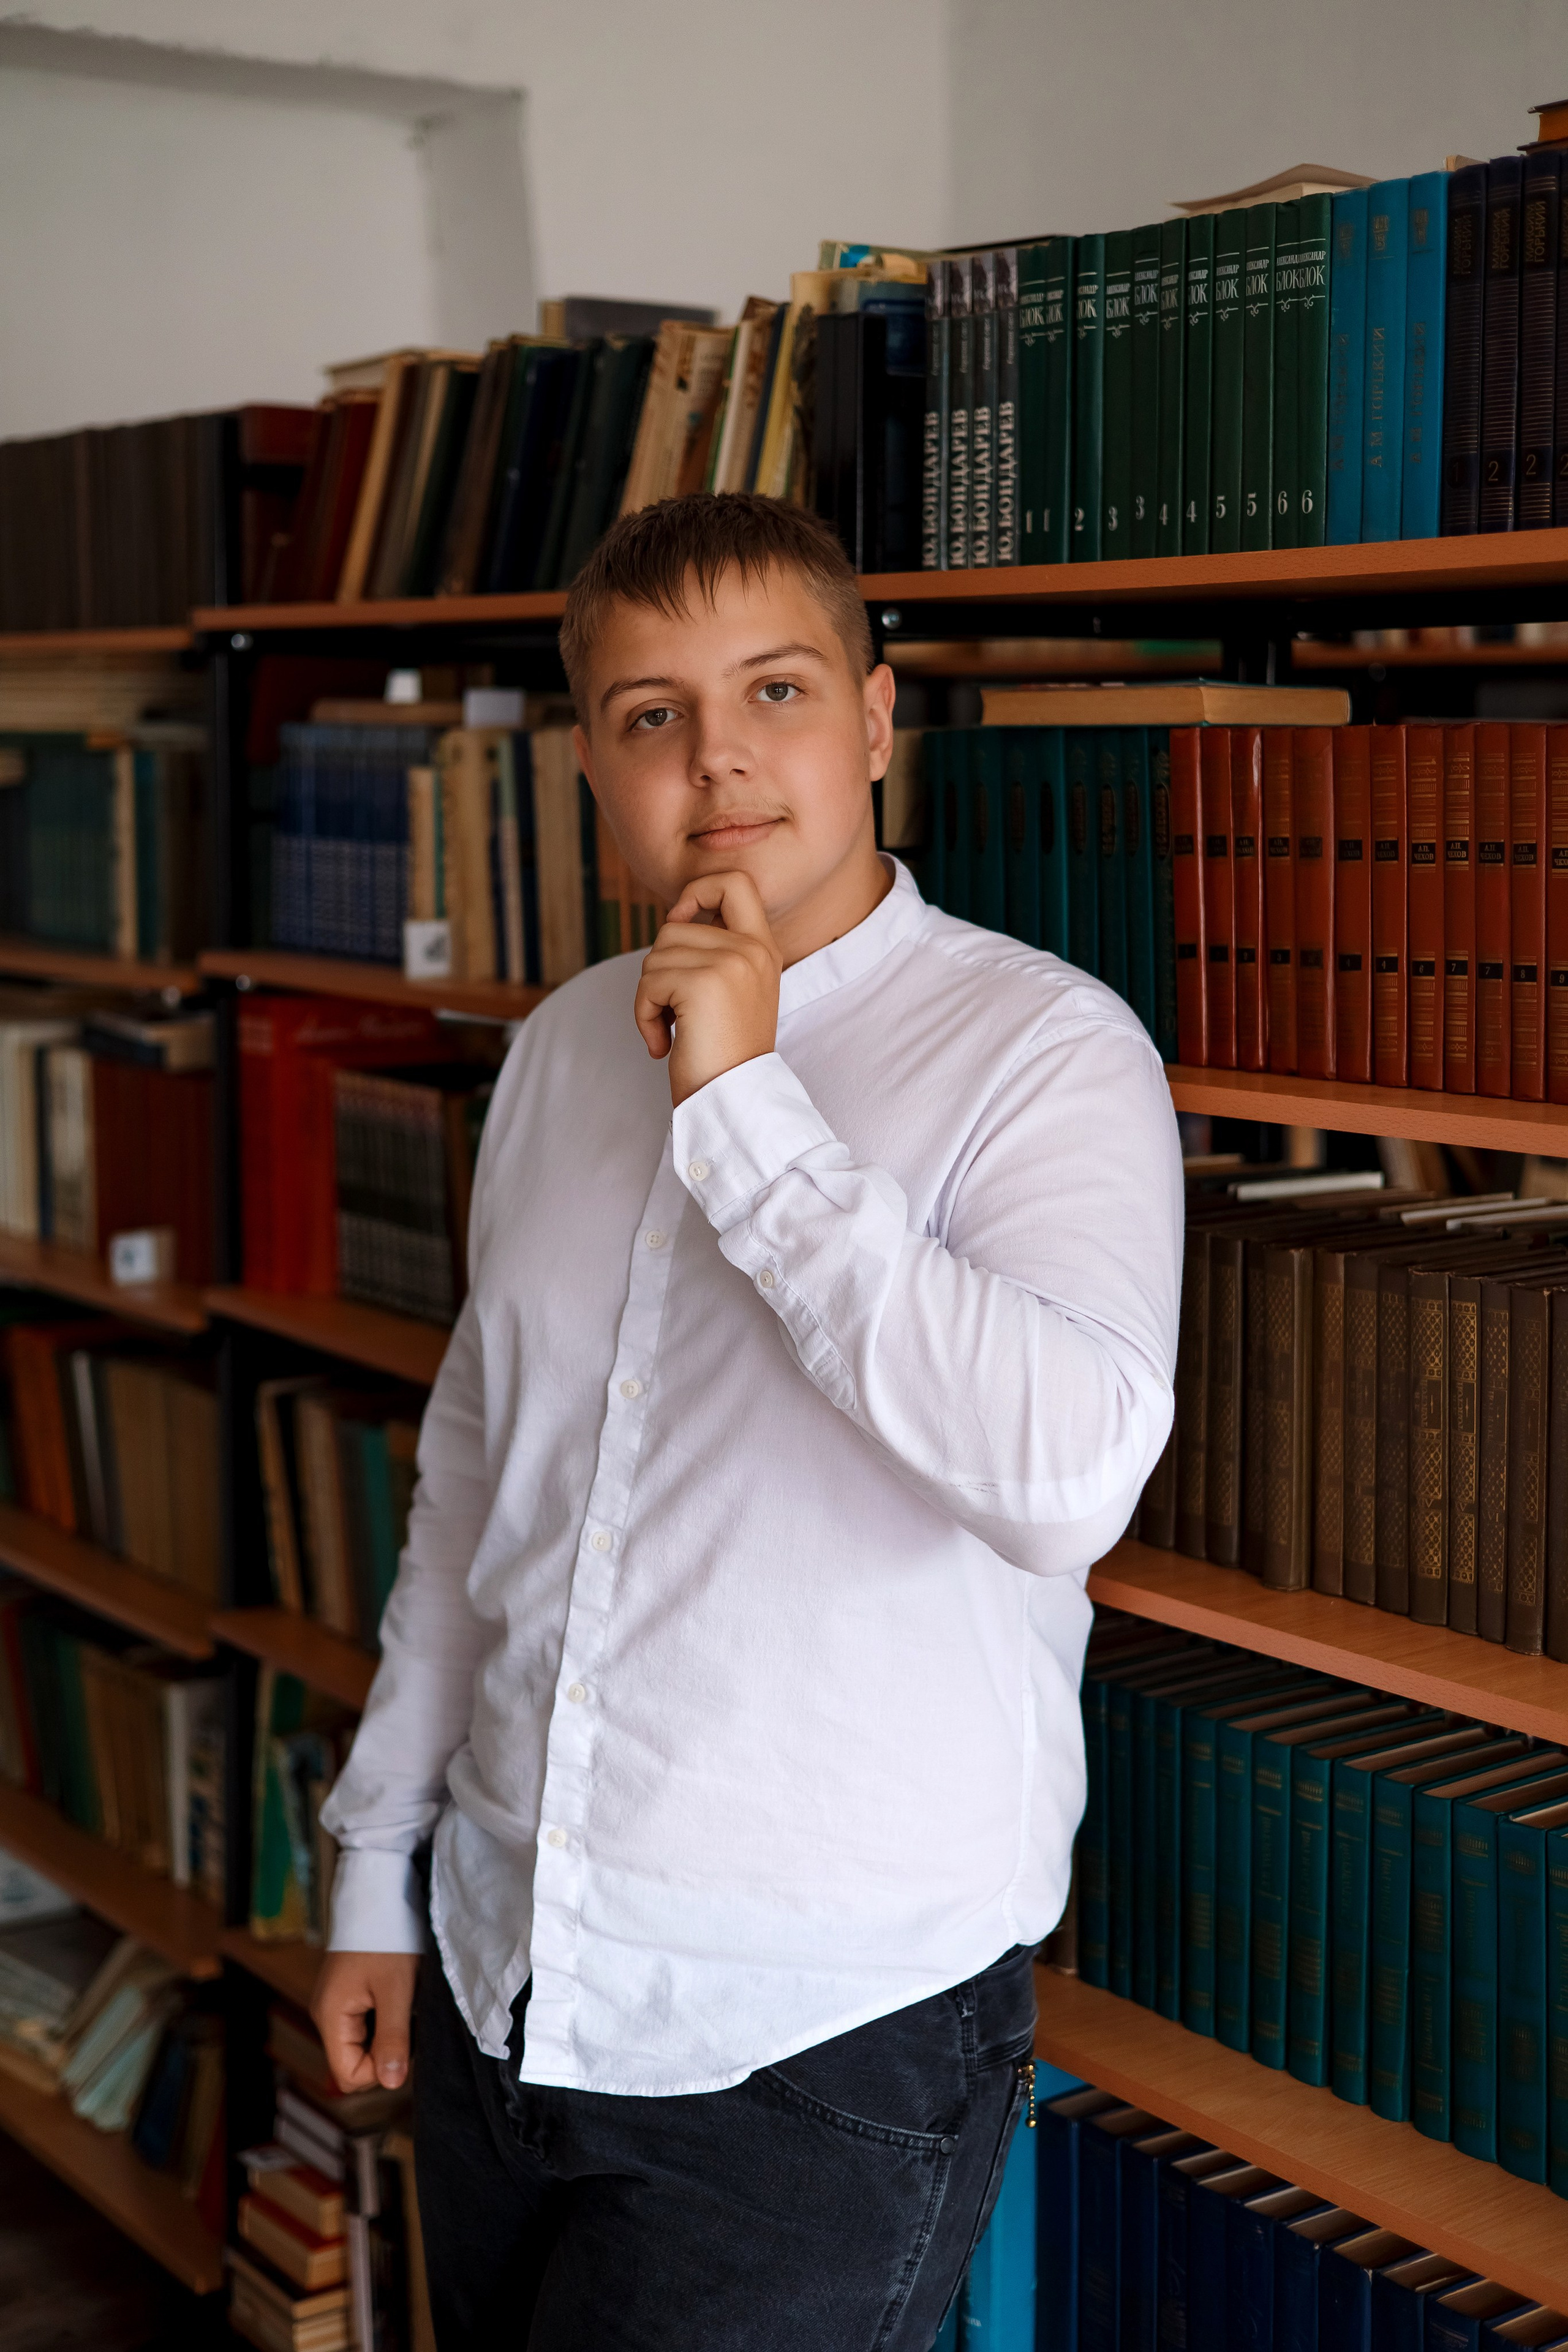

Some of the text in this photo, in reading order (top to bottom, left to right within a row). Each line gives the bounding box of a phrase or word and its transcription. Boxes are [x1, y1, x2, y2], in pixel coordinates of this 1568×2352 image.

[1526, 204, 1534, 262] МАКСИМ
[1216, 279, 1239, 301] БЛОК
[1246, 274, 1268, 296] БЛОК
[1276, 265, 1325, 291] БЛОК БЛОК
[1134, 284, 1158, 306] БЛОК
[1106, 297, 1130, 319] БЛОК
[951, 408, 970, 534] БОНДАРЕВ
[974, 405, 993, 533] БОНДАРЕВ
[998, 401, 1017, 529] БОНДАРЕВ
[1488, 461, 1499, 481] 2
[1526, 454, 1537, 475] 2
[1559, 454, 1568, 475] 2
[1136, 495, 1145, 520] 3
[1186, 500, 1197, 522] 4
[1216, 495, 1226, 519] 5
[1247, 492, 1256, 517] 5
[1278, 491, 1288, 515] 6
[1302, 489, 1313, 514] 6
[1026, 508, 1033, 533] 1
[1044, 507, 1050, 532] 1
[1075, 507, 1085, 531] 2
[1109, 505, 1118, 531] 3
[1159, 503, 1168, 526] 4
[1451, 963, 1457, 972] 7
[1485, 967, 1490, 975] 7
[1520, 969, 1525, 979] 8
[1559, 974, 1564, 984] 9
